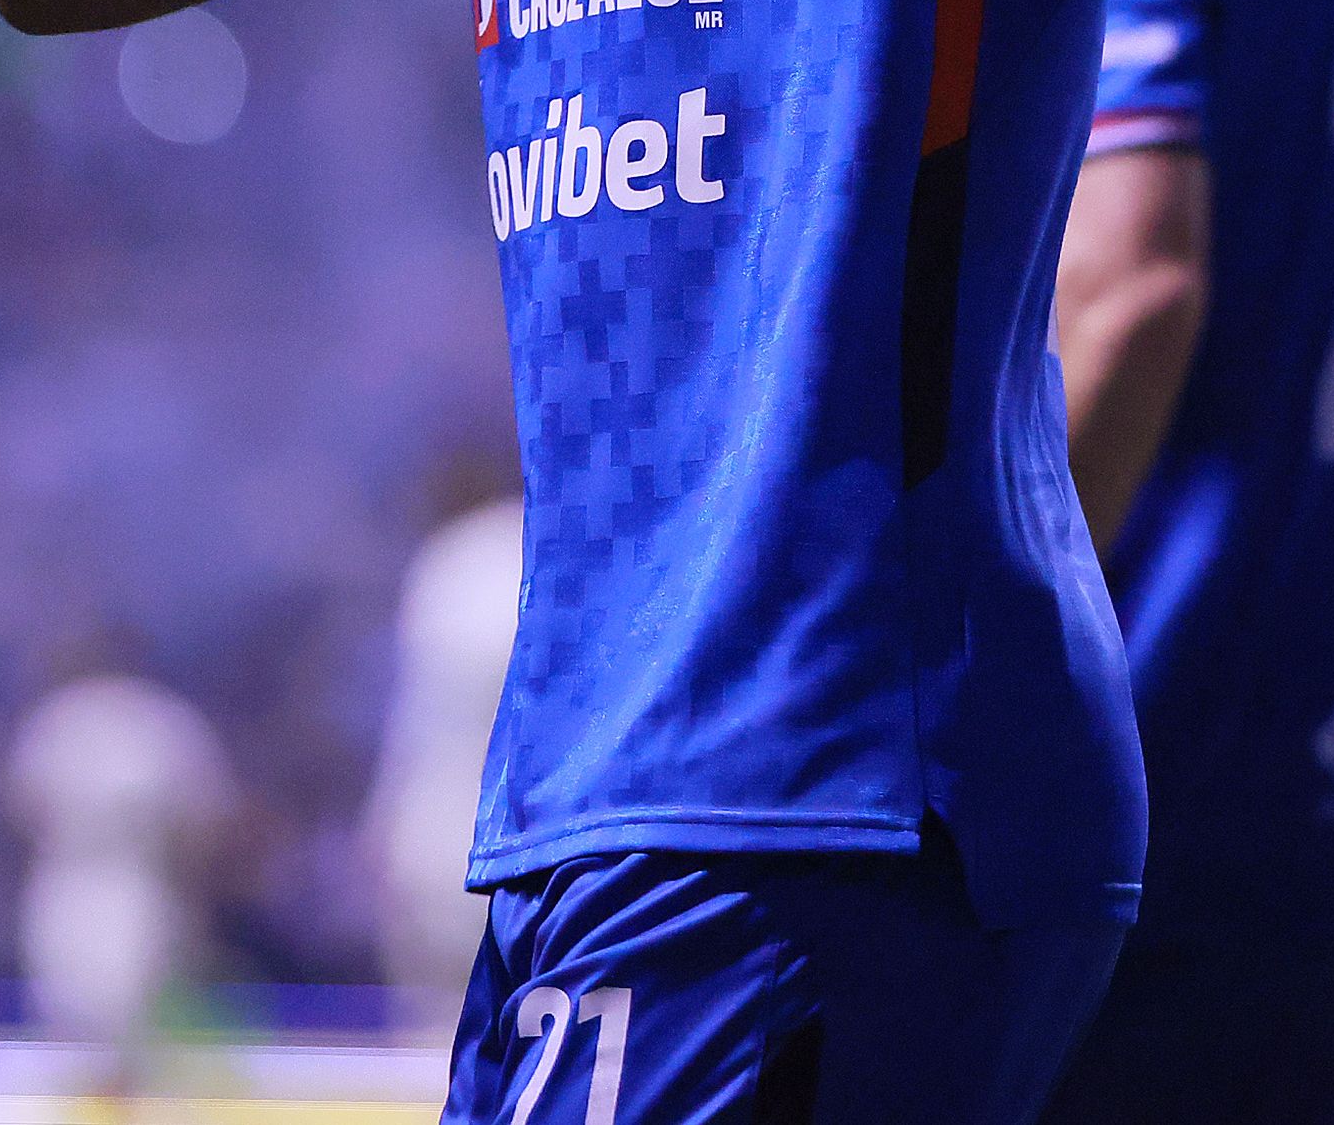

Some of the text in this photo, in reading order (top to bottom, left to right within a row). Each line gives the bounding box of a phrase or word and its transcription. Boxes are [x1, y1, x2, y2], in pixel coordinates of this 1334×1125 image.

[695, 11, 723, 29] MR
[487, 87, 726, 241] ovibet
[510, 986, 632, 1125] 21
